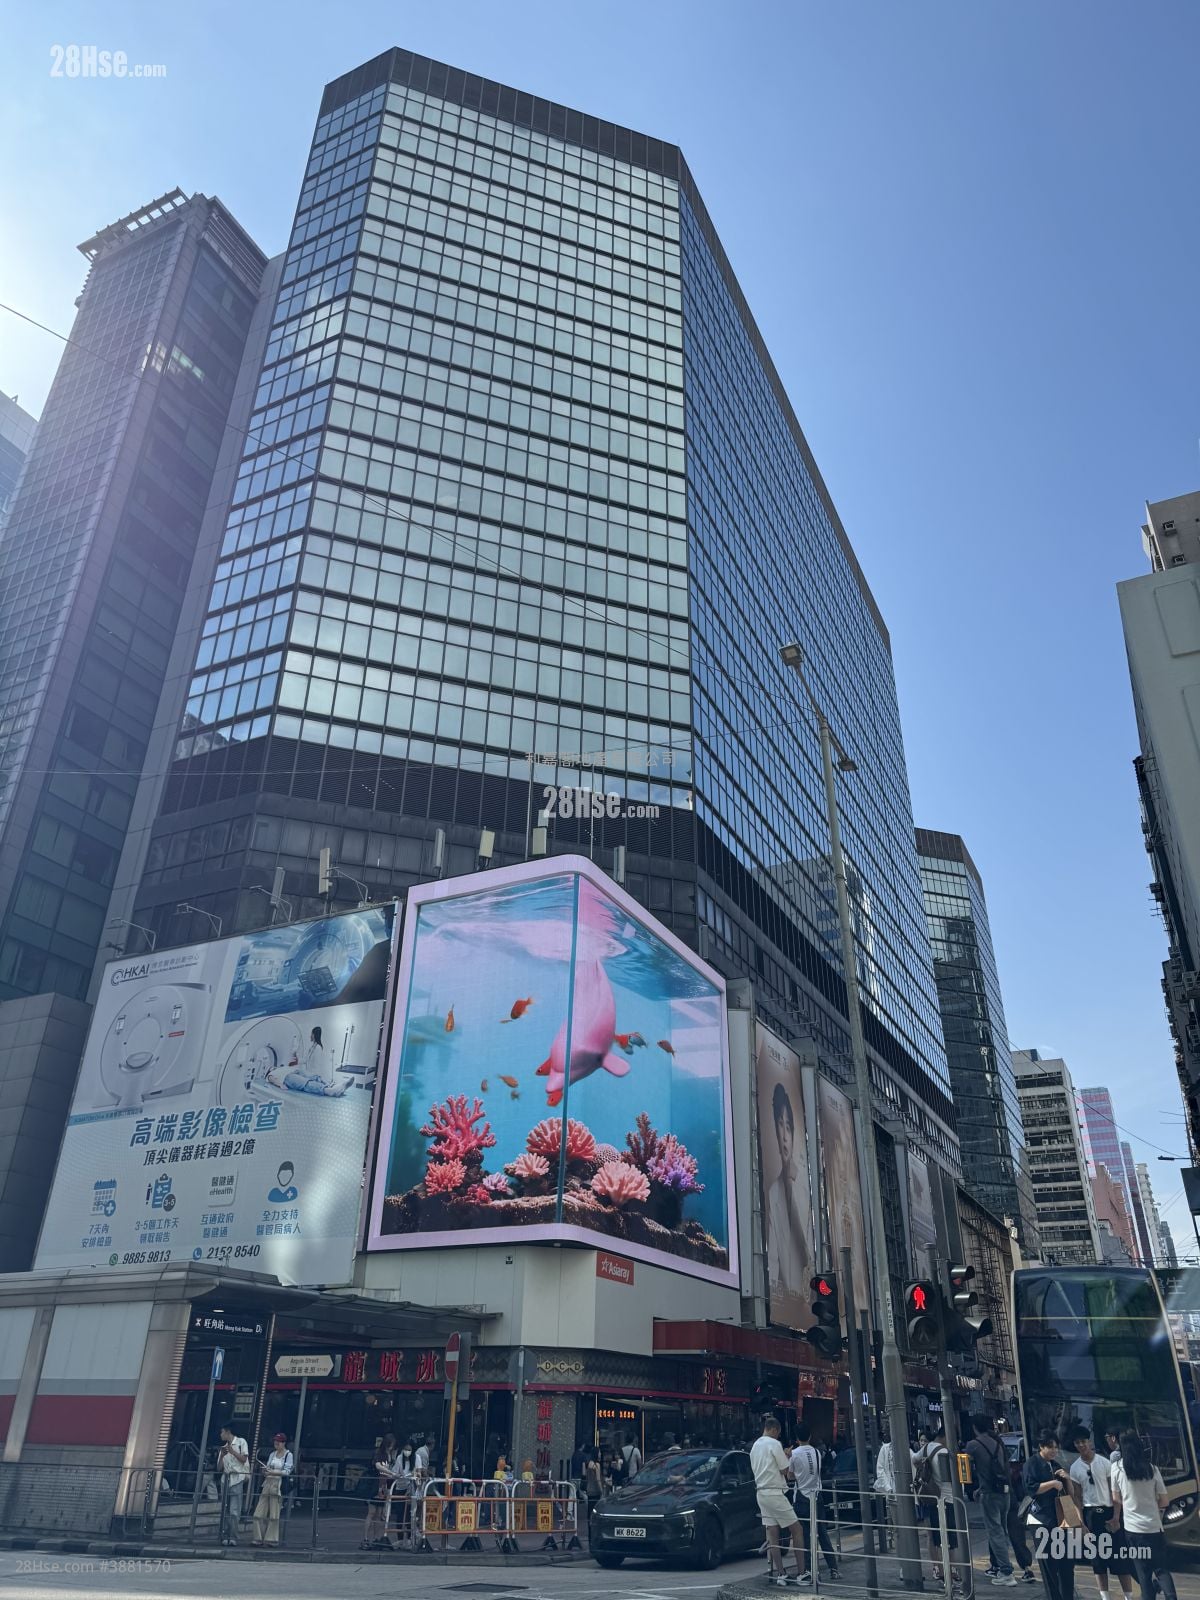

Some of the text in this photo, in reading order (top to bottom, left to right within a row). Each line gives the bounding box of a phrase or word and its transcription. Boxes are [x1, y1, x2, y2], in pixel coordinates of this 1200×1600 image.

[129, 1101, 283, 1147] 高端影像檢查
[143, 1139, 256, 1166] 頂尖儀器耗資過2億
[209, 1187, 234, 1196] eHealth
[201, 1212, 235, 1226] 互通政府
[262, 1209, 299, 1221] 全力支持
[255, 1222, 302, 1236] 醫管局病人
[122, 1250, 171, 1265] 9885 9813
[234, 1244, 261, 1258] 8540
[608, 1261, 630, 1283] Asiaray
[203, 1318, 225, 1331] 旺角站
[626, 1528, 645, 1537] 8622
